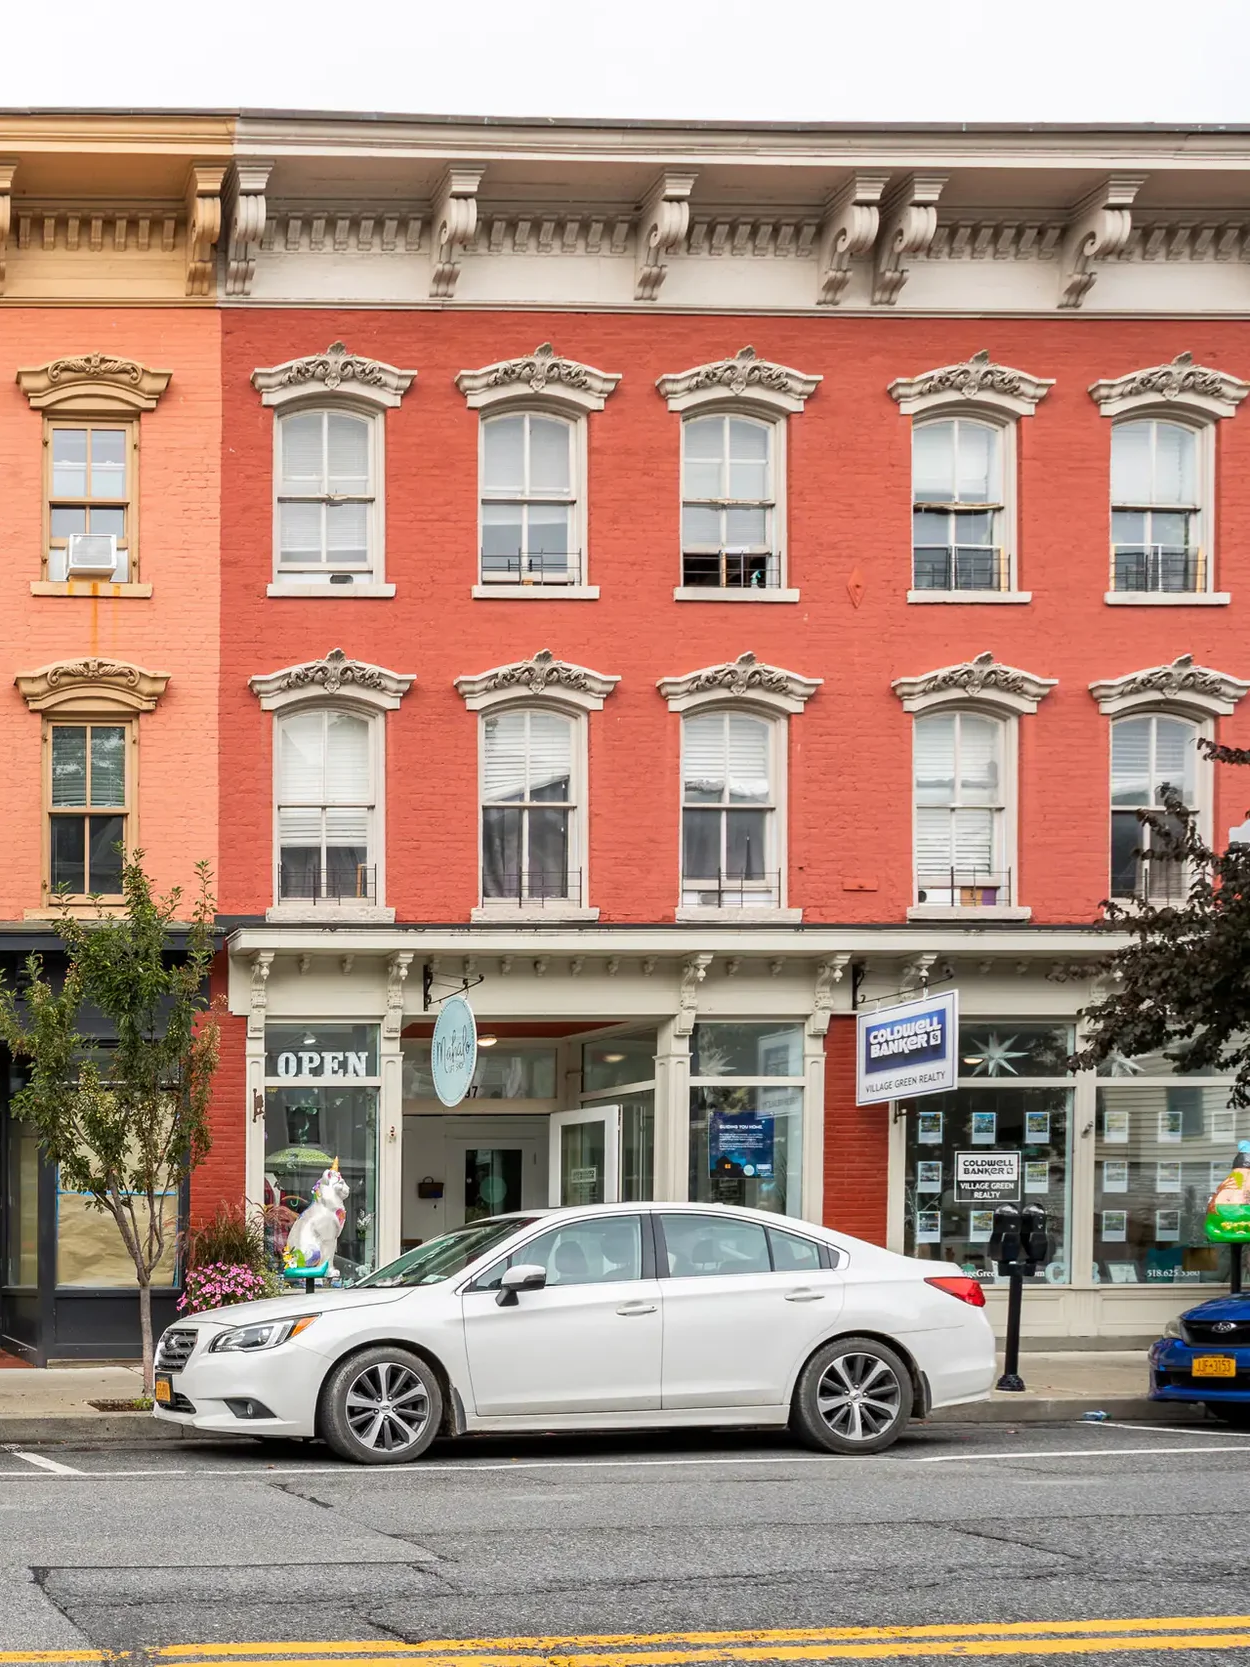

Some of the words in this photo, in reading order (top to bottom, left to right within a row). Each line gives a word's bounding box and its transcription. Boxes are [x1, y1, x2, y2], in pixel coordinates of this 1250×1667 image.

[437, 1025, 471, 1073] Mahalo
[277, 1051, 368, 1078] OPEN
[866, 1080, 892, 1094] VILLAGE
[894, 1077, 918, 1089] GREEN
[919, 1070, 946, 1083] REALTY
